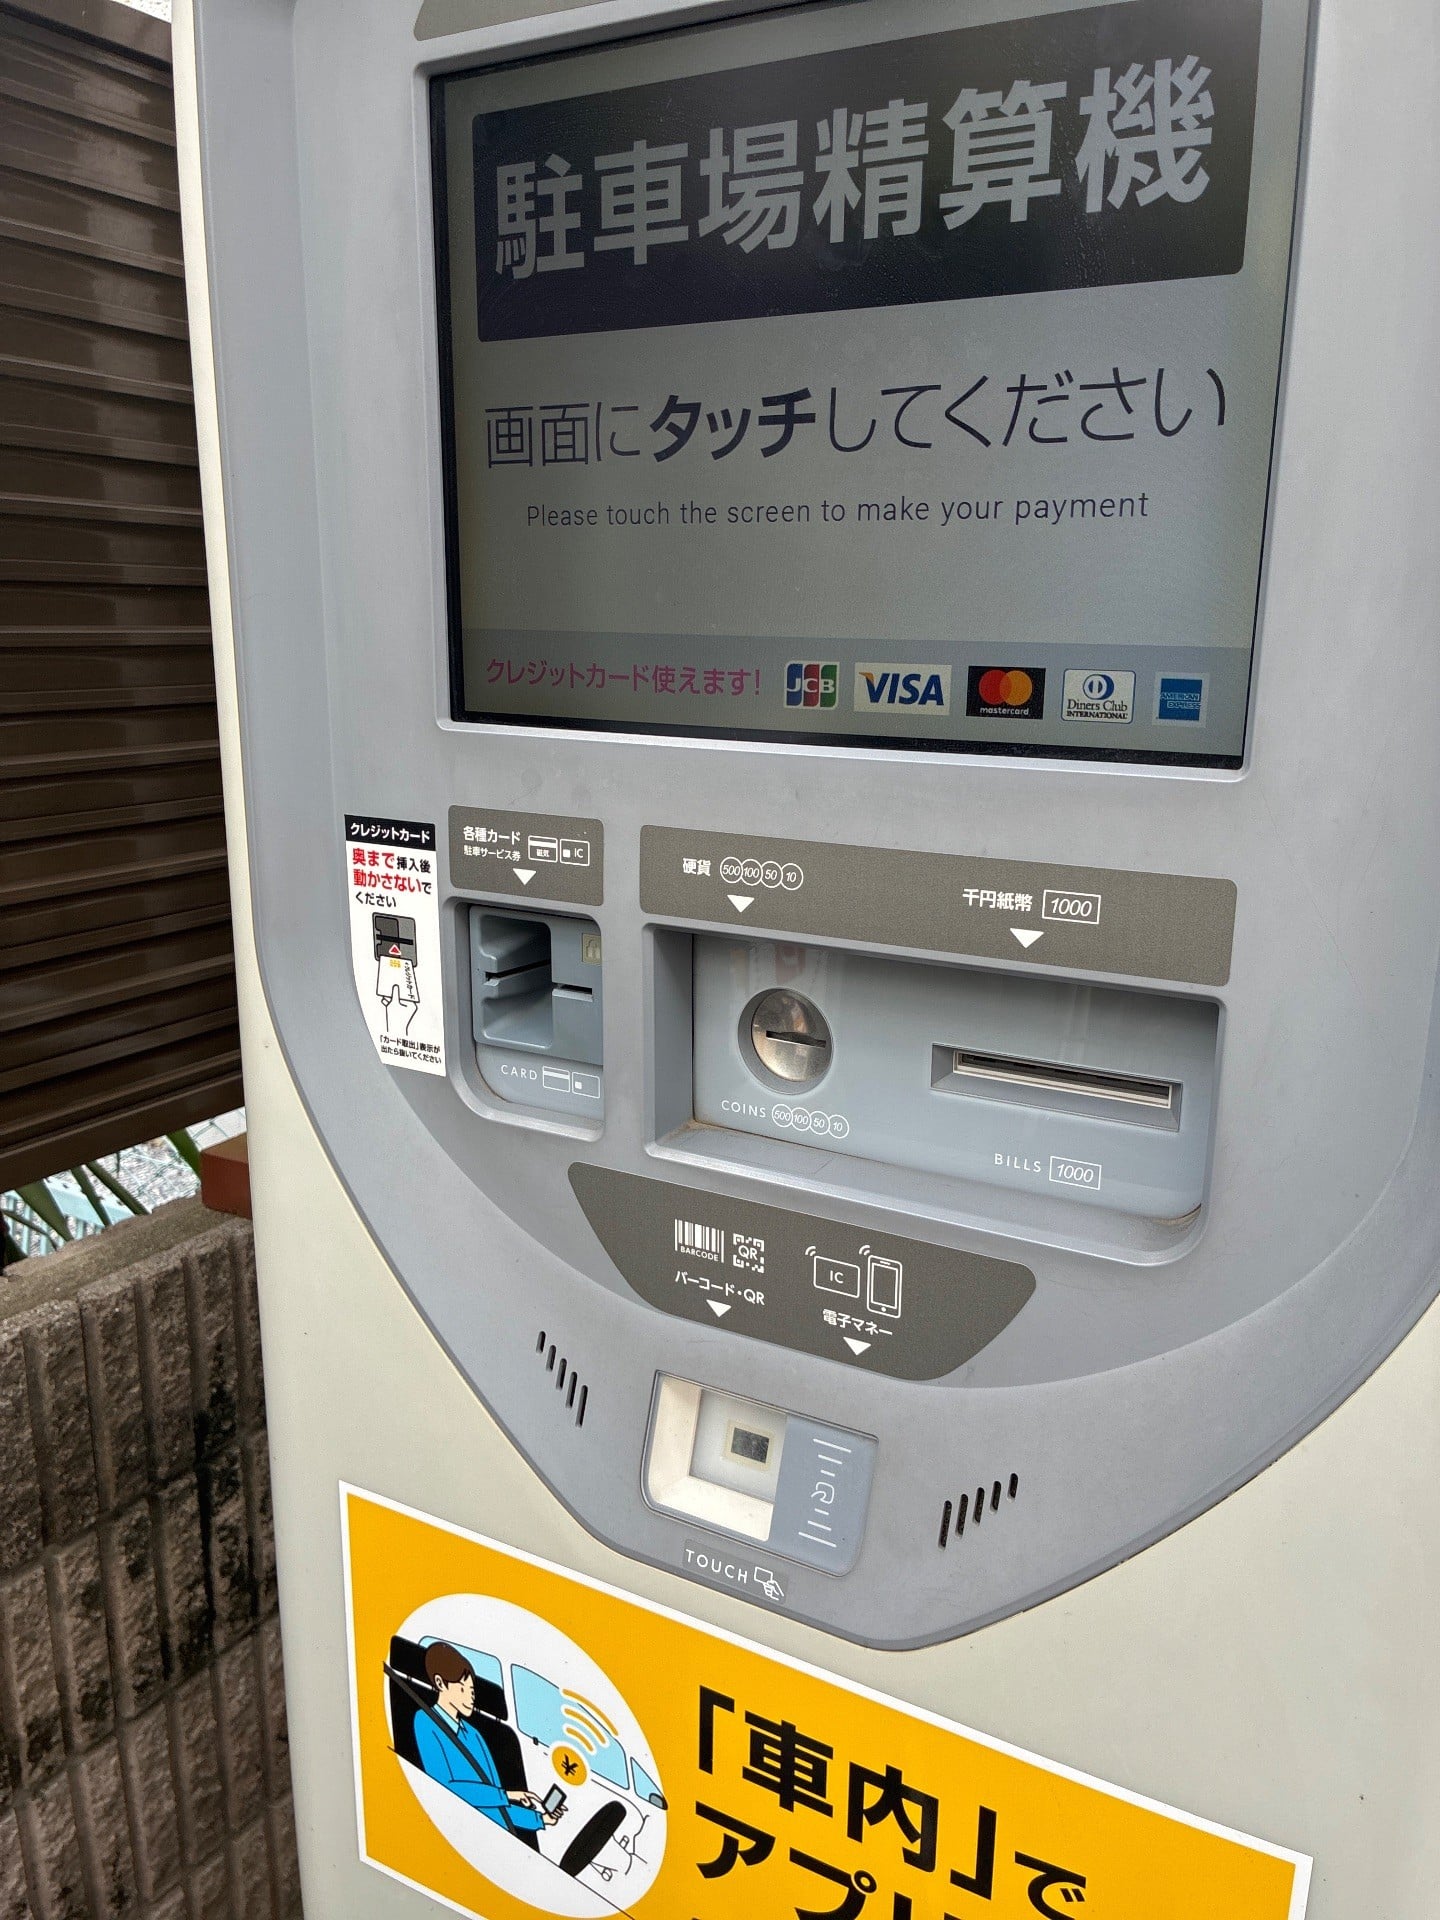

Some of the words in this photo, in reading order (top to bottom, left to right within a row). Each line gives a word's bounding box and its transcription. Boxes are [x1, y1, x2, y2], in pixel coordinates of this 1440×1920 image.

[495, 55, 1215, 281] 駐車場精算機
[486, 367, 1226, 468] 画面にタッチしてください
[527, 504, 599, 526] Please
[606, 501, 670, 525] touch
[679, 500, 717, 524] the
[727, 502, 811, 523] screen
[821, 499, 846, 522] to
[857, 496, 930, 521] make
[940, 499, 1004, 526] your
[1015, 492, 1149, 525] payment
[486, 658, 761, 696] クレジットカード使えます!
[859, 671, 944, 706] VISA
[1160, 691, 1200, 701] AMERICAN
[979, 706, 1030, 716] mastercard
[1066, 710, 1129, 720] INTERNATIONAL
[1067, 698, 1101, 711] Diners
[1102, 699, 1128, 712] Club
[1166, 700, 1201, 710] EXPRESS
[350, 822, 430, 844] クレジットカード
[463, 825, 521, 845] 各種カード
[463, 845, 521, 862] 駐車サービス券
[574, 847, 584, 858] IC
[682, 857, 711, 878] 硬貨
[722, 863, 741, 877] 500
[742, 865, 760, 879] 100
[764, 867, 778, 882] 50
[785, 870, 797, 883] 10
[353, 868, 432, 895] 動かさないで
[355, 891, 397, 908] ください
[962, 888, 1033, 913] 千円紙幣
[1049, 896, 1093, 919] 1000
[500, 1063, 539, 1081] CARD
[721, 1098, 767, 1120] COINS
[773, 1109, 791, 1125] 500
[792, 1112, 810, 1127] 100
[812, 1116, 826, 1131] 50
[831, 1119, 844, 1133] 10
[993, 1152, 1043, 1174] BILLS
[1055, 1162, 1095, 1184] 1000
[680, 1245, 719, 1262] BARCODE
[738, 1244, 758, 1261] QR
[829, 1269, 845, 1285] IC
[674, 1270, 766, 1306] バーコード・QR
[822, 1308, 894, 1336] 電子マネー
[685, 1548, 749, 1585] TOUCH
[698, 1684, 1087, 1920] 「車内」で
